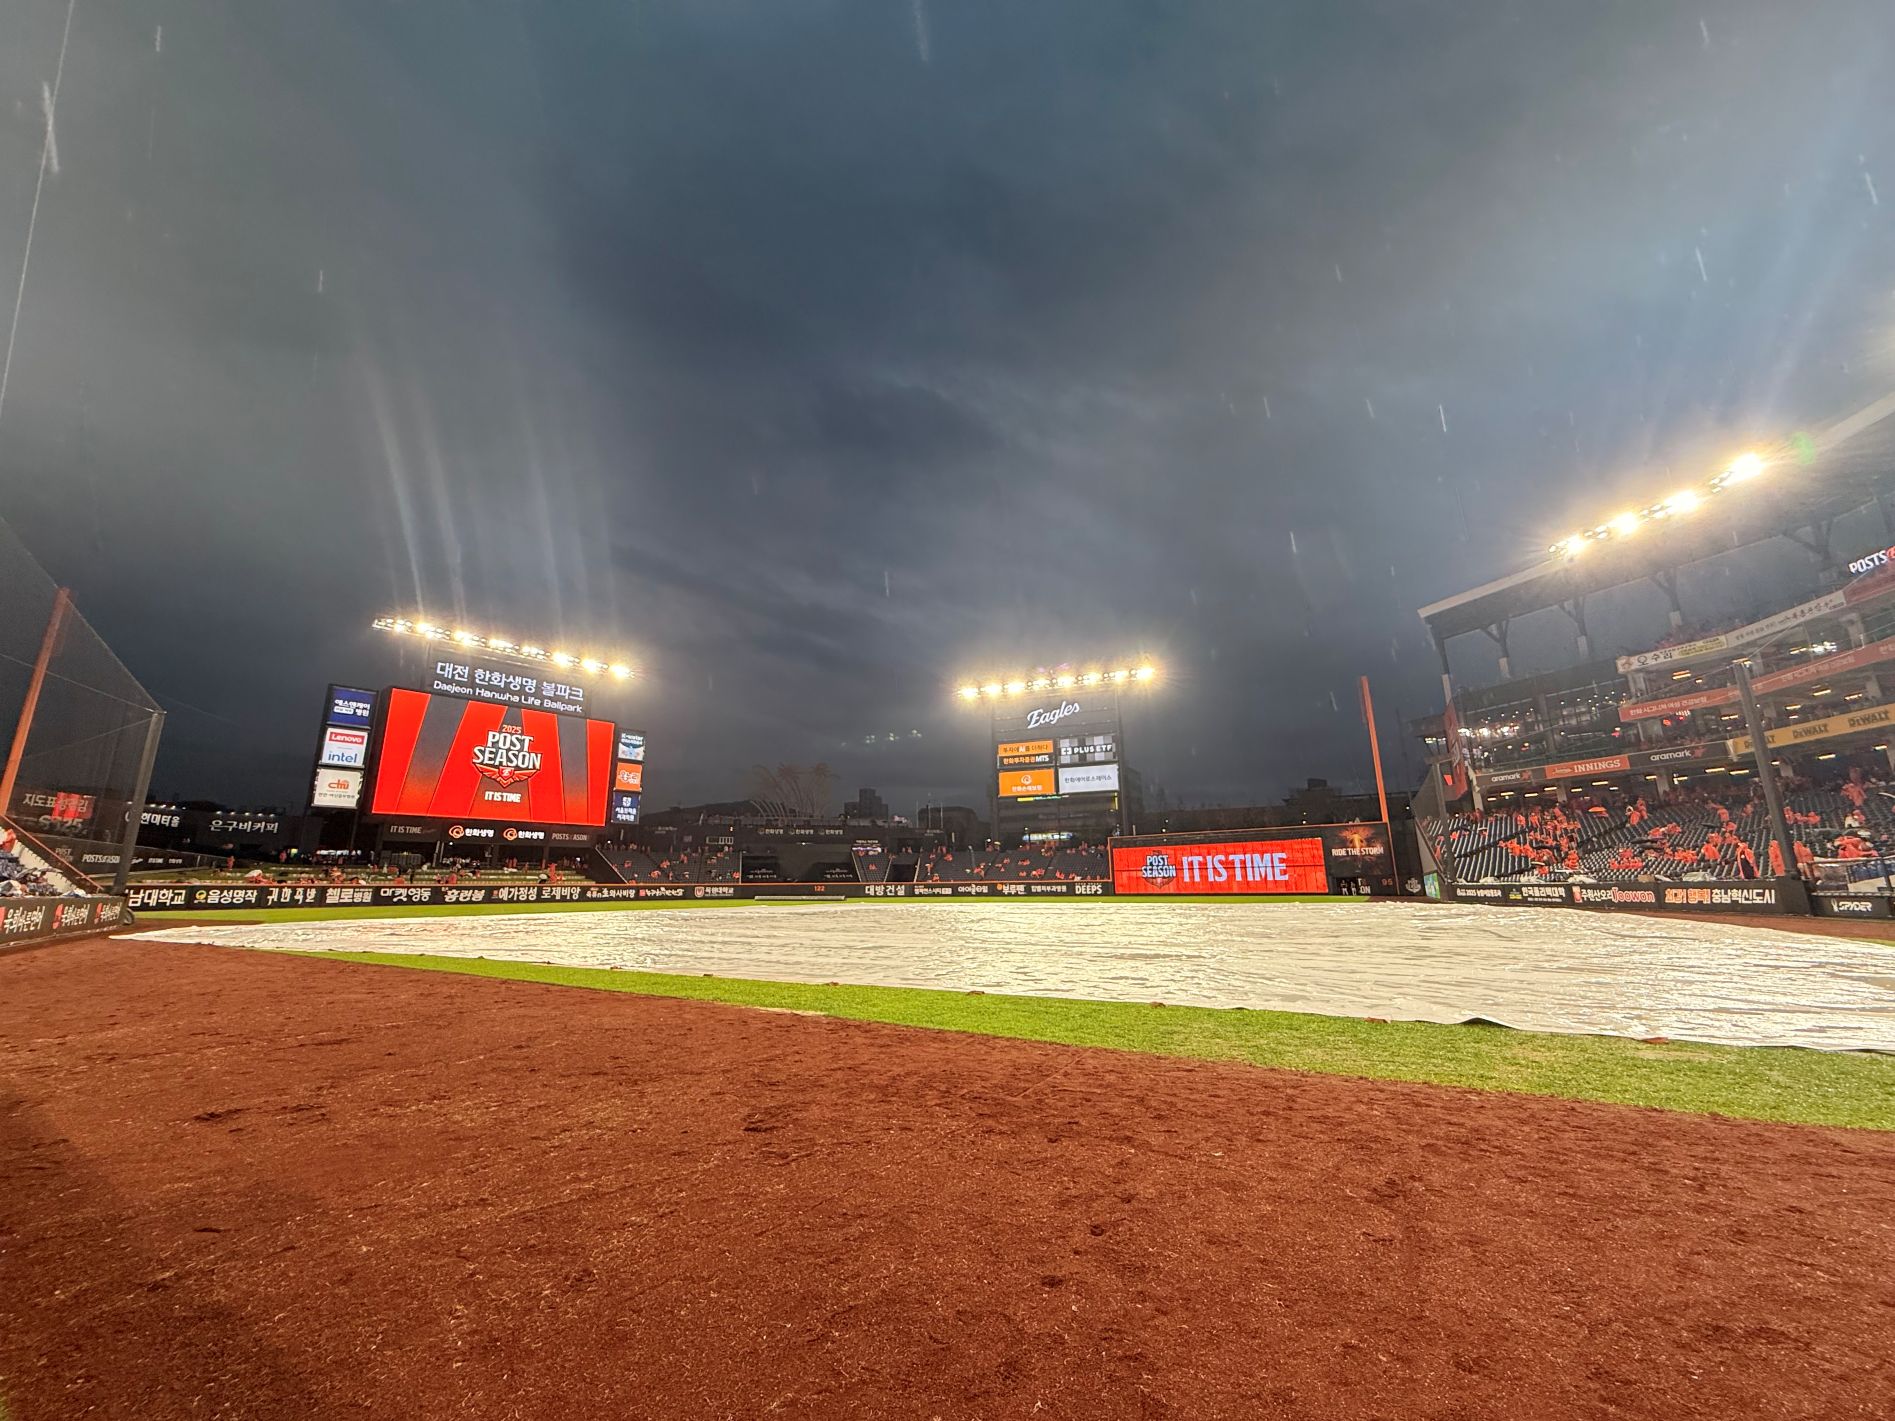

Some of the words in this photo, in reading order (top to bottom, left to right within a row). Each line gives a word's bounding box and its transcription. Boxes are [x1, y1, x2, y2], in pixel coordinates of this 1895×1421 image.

[436, 662, 469, 682] 대전
[475, 669, 537, 693] 한화생명
[541, 681, 584, 701] 볼파크
[433, 681, 473, 695] Daejeon
[475, 688, 520, 702] Hanwha
[521, 696, 541, 706] Life
[543, 700, 583, 713] Ballpark
[1027, 701, 1080, 729] Eagles
[502, 725, 522, 734] 2025
[331, 733, 362, 744] Lenovo
[487, 731, 534, 752] POST
[1073, 745, 1095, 754] PLUS
[1096, 744, 1112, 752] ETF
[1650, 749, 1692, 761] aramark
[328, 751, 358, 763] intel
[472, 746, 542, 770] SEASON
[1573, 759, 1621, 773] INNINGS
[1491, 772, 1521, 782] aramark
[22, 793, 57, 808] 지도표
[485, 791, 494, 801] IT
[494, 791, 502, 801] IS
[502, 792, 522, 803] TIME
[210, 819, 280, 834] 은구비커피
[390, 825, 397, 833] IT
[398, 825, 405, 833] IS
[405, 826, 422, 834] TIME
[465, 828, 495, 838] 한화생명
[518, 830, 545, 840] 한화생명
[551, 832, 588, 841] POSTSASON
[1331, 848, 1347, 857] RIDE
[1348, 847, 1361, 856] THE
[1361, 846, 1384, 855] STORM
[1146, 855, 1169, 866] POST
[1182, 856, 1203, 882] IT
[1206, 855, 1227, 882] IS
[1228, 852, 1289, 881] TIME
[1141, 865, 1177, 878] SEASON
[207, 888, 258, 904] 음성명작
[380, 888, 432, 902] 마켓영동
[498, 887, 538, 901] 예가정성
[541, 887, 582, 900] 로제비앙
[865, 884, 905, 896] 대방건설
[1075, 885, 1102, 895] DEEPS
[1612, 887, 1656, 903] Joowon
[1712, 888, 1776, 904] 충남혁신도시
[126, 888, 186, 907] 남대학교
[1838, 901, 1873, 912] SPYDER
